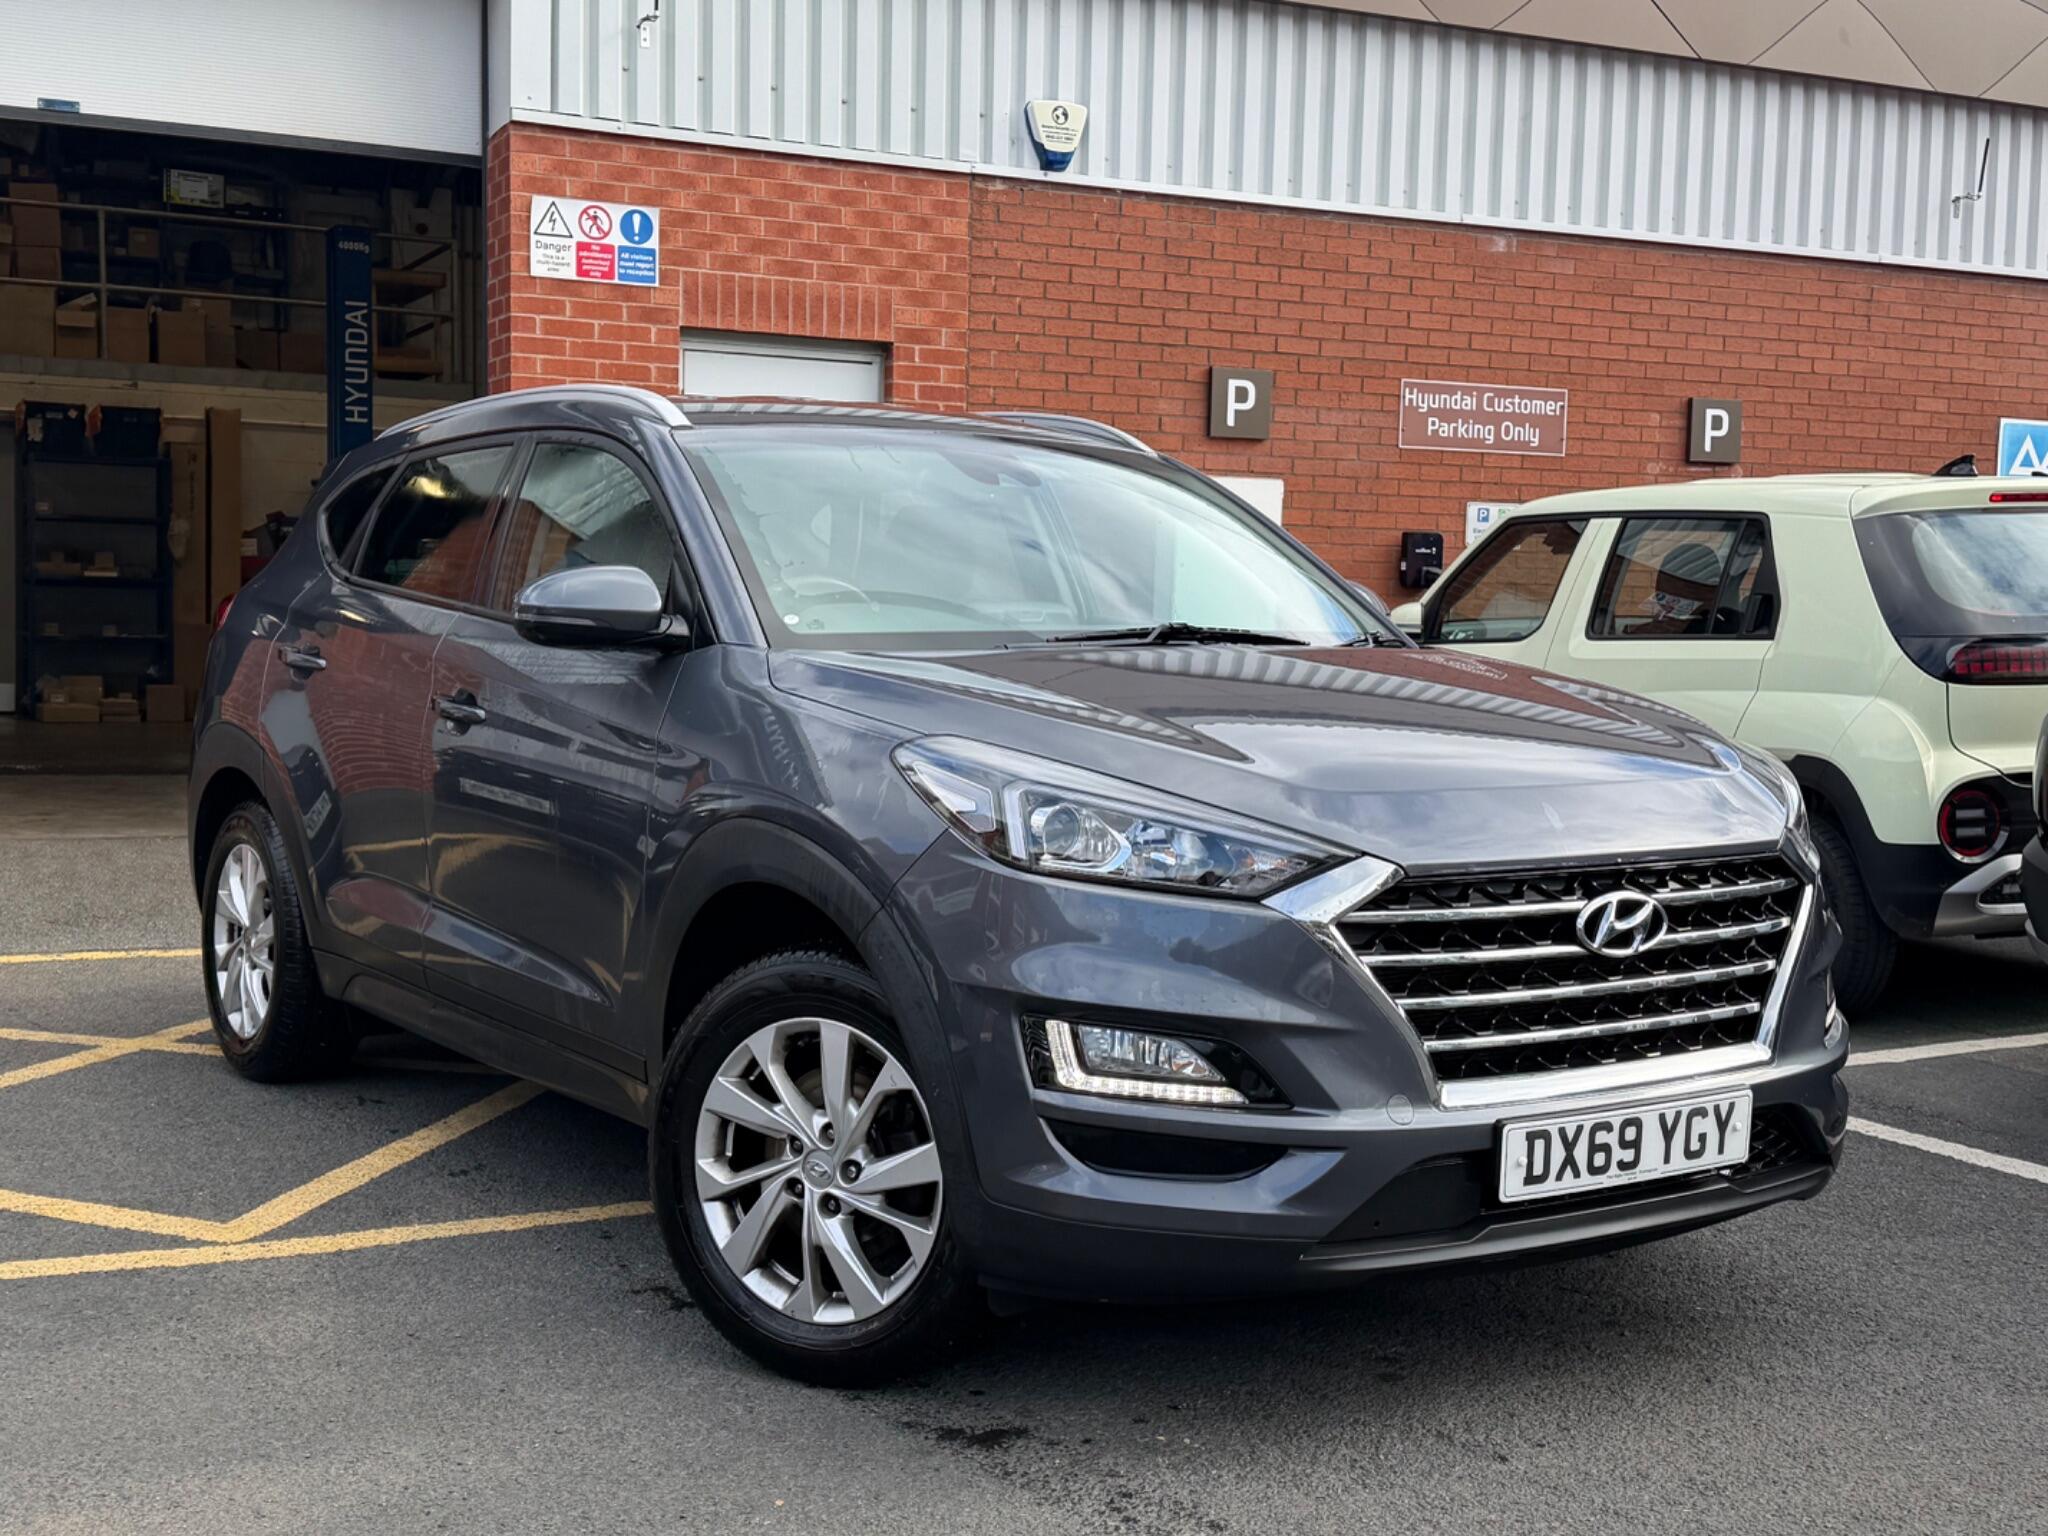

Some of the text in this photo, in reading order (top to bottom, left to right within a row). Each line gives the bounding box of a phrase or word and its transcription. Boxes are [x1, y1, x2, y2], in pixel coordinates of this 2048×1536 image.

[535, 240, 572, 253] Danger
[345, 301, 368, 423] HYUNDAI
[1226, 378, 1256, 427] P
[1404, 387, 1564, 416] Hyundai Customer
[1427, 417, 1540, 447] Parking Only
[1704, 408, 1729, 453] P
[1523, 1101, 1736, 1186] DX69 YGY
